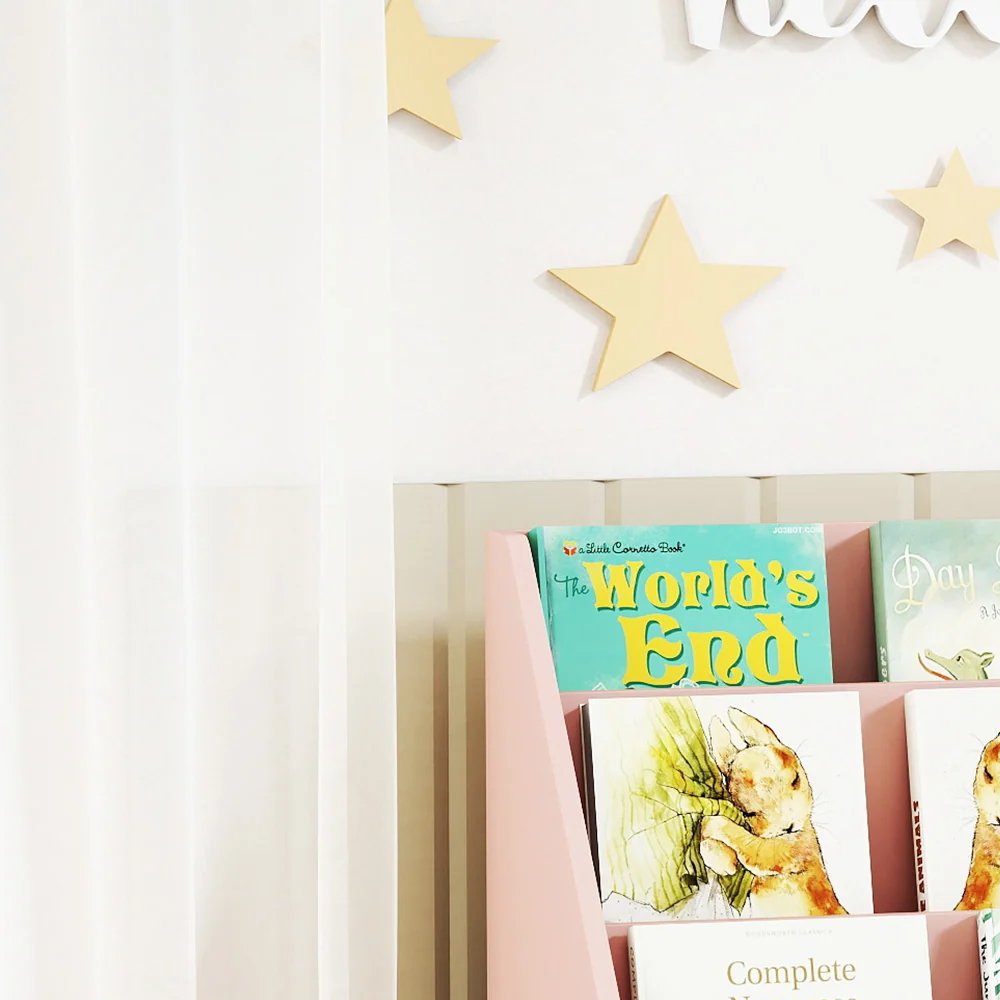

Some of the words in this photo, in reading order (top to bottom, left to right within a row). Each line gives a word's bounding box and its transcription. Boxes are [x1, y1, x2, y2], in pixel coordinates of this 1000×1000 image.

[586, 542, 611, 554] Little
[612, 541, 657, 554] Cornetto
[554, 573, 590, 599] The
[582, 559, 820, 612] World's
[891, 543, 977, 614] Day
[979, 605, 989, 619] A
[617, 611, 804, 687] End
[980, 935, 988, 965] The
[726, 957, 857, 991] Complete
